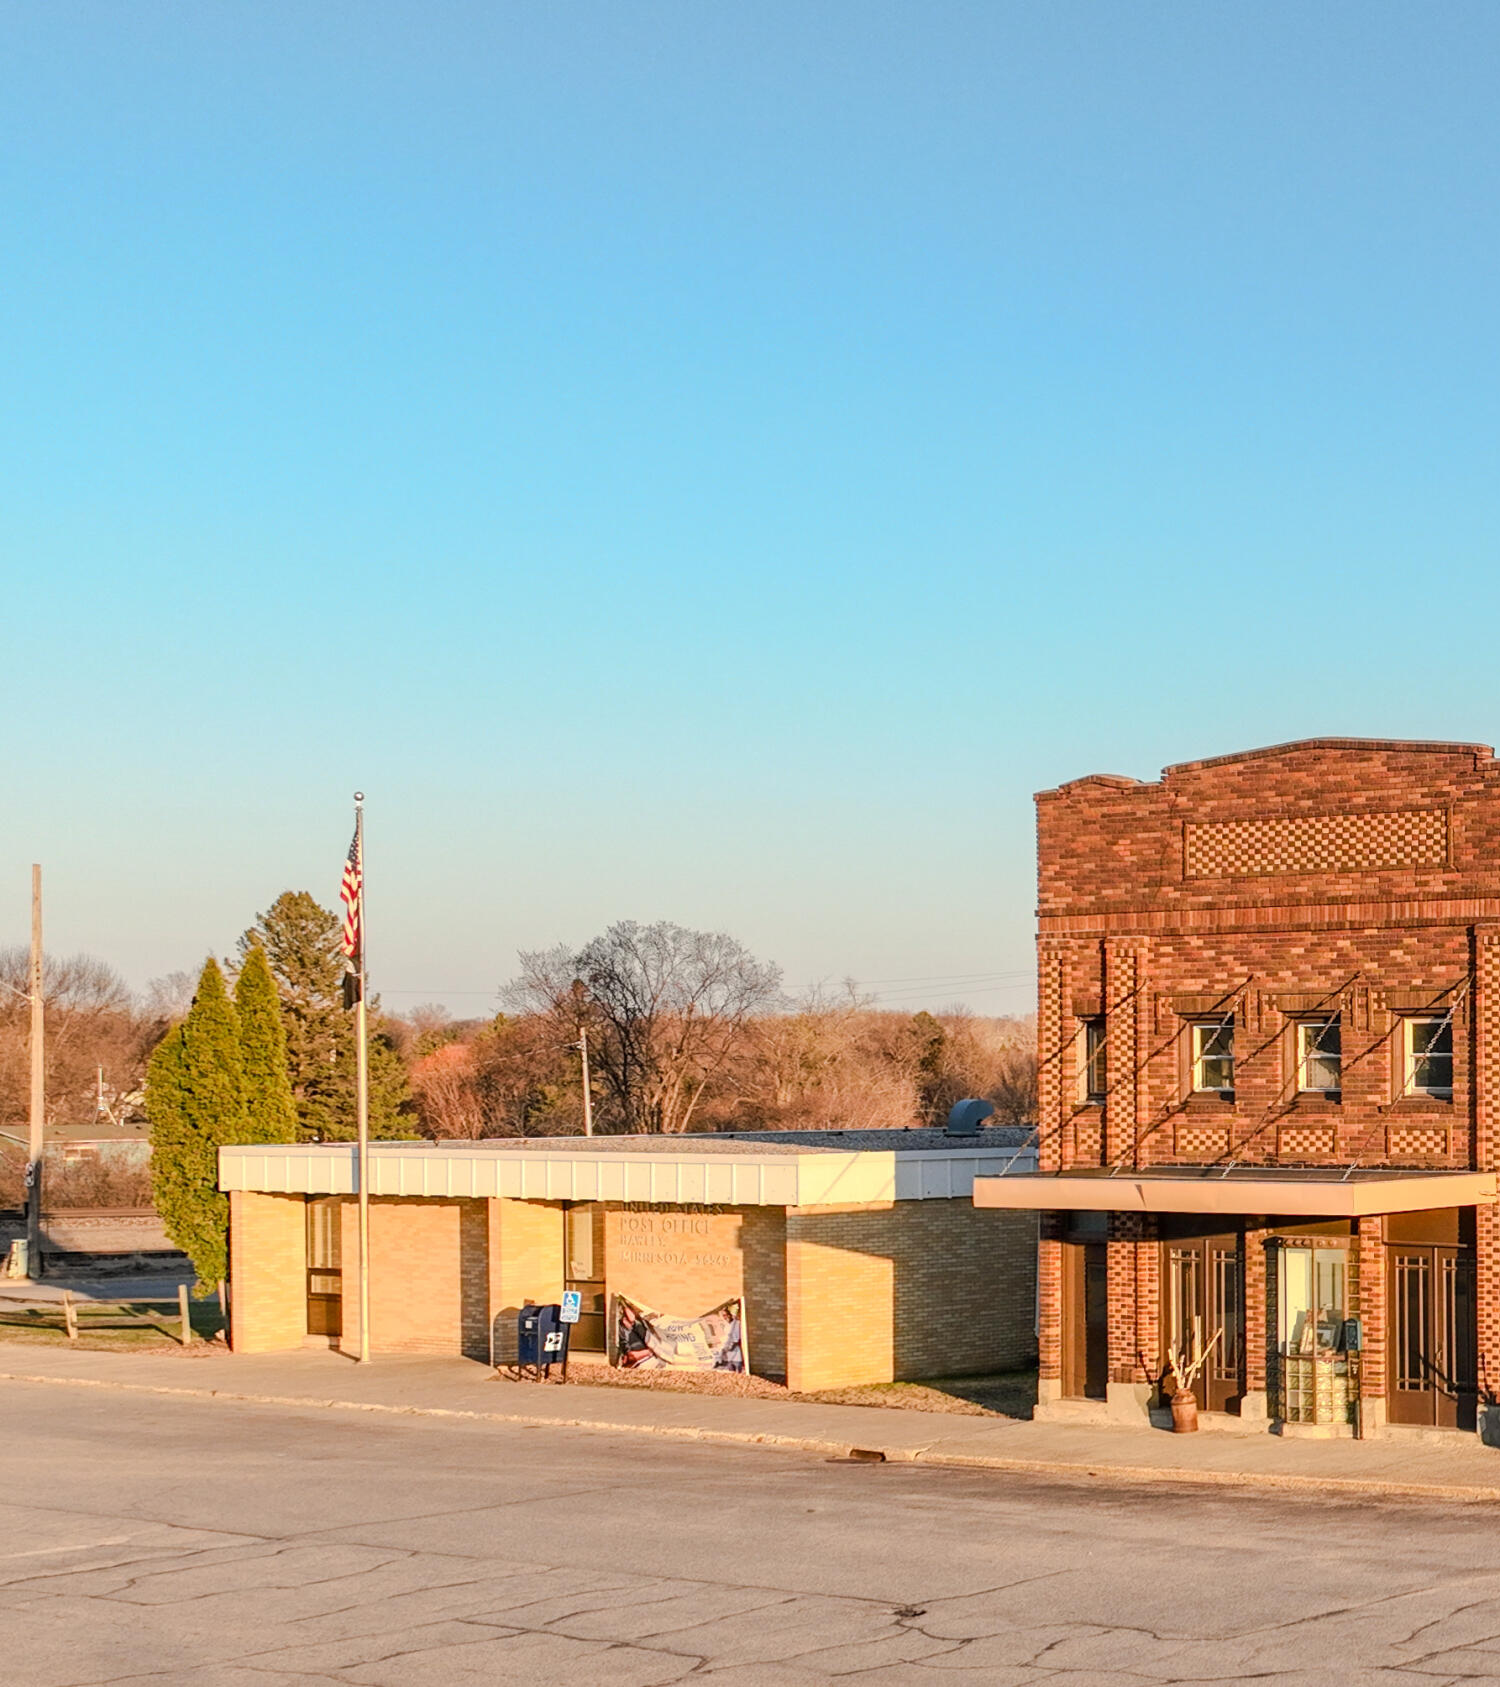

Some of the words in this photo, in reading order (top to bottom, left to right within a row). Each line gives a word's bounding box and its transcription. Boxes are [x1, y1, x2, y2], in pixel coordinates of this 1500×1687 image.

[619, 1217, 654, 1233] POST
[662, 1218, 711, 1234] OFFICE
[620, 1250, 688, 1265] MINNESOTA
